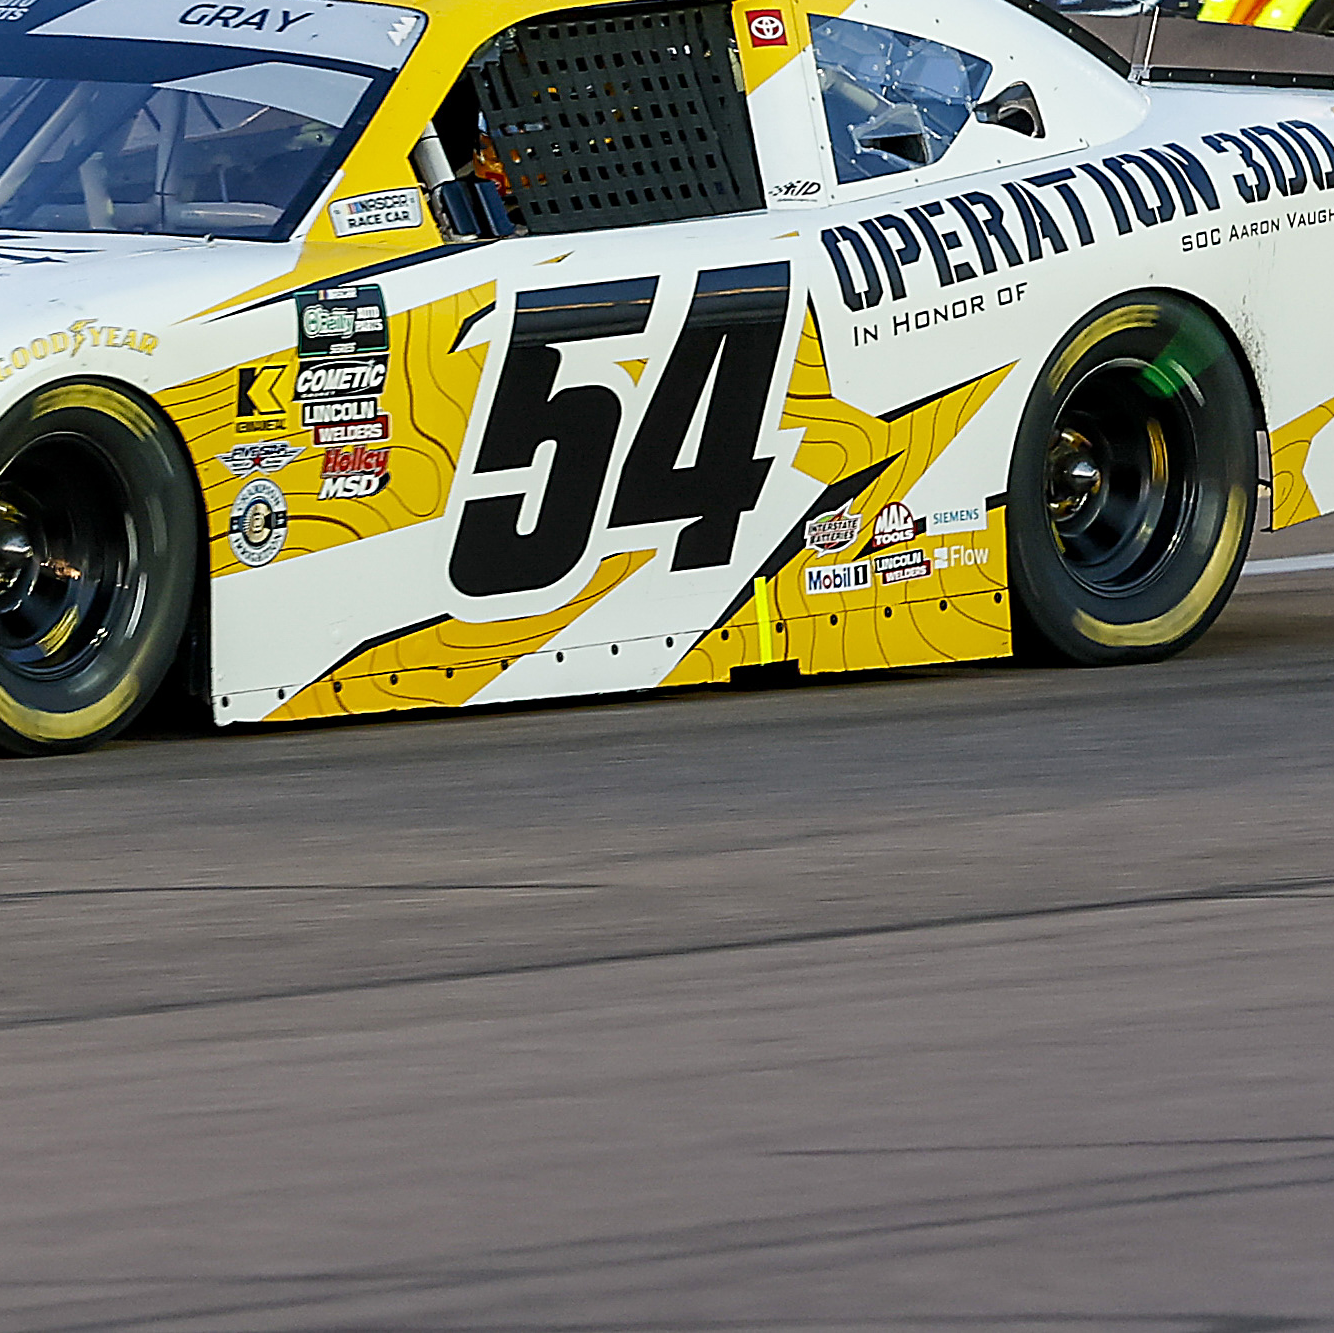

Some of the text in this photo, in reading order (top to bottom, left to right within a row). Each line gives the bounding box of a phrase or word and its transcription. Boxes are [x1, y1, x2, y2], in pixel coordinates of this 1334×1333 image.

[178, 3, 315, 33] GRAY
[347, 210, 412, 228] RACE CAR
[820, 142, 1221, 313] OPERATION
[1182, 227, 1222, 253] SOC
[998, 282, 1029, 307] OF
[296, 363, 386, 393] COMETIC
[304, 401, 375, 424] LINCOLN
[318, 423, 384, 443] WELDERS
[448, 260, 792, 598] 54
[318, 474, 380, 500] MSD
[808, 519, 857, 534] INTERSTATE
[877, 504, 915, 534] MAC
[933, 509, 979, 525] SIEMENS
[809, 530, 854, 544] BATTERIES
[873, 530, 915, 546] TOOLS
[876, 551, 922, 572] LINCOLN
[951, 545, 989, 567] Flow
[808, 566, 851, 591] Mobil
